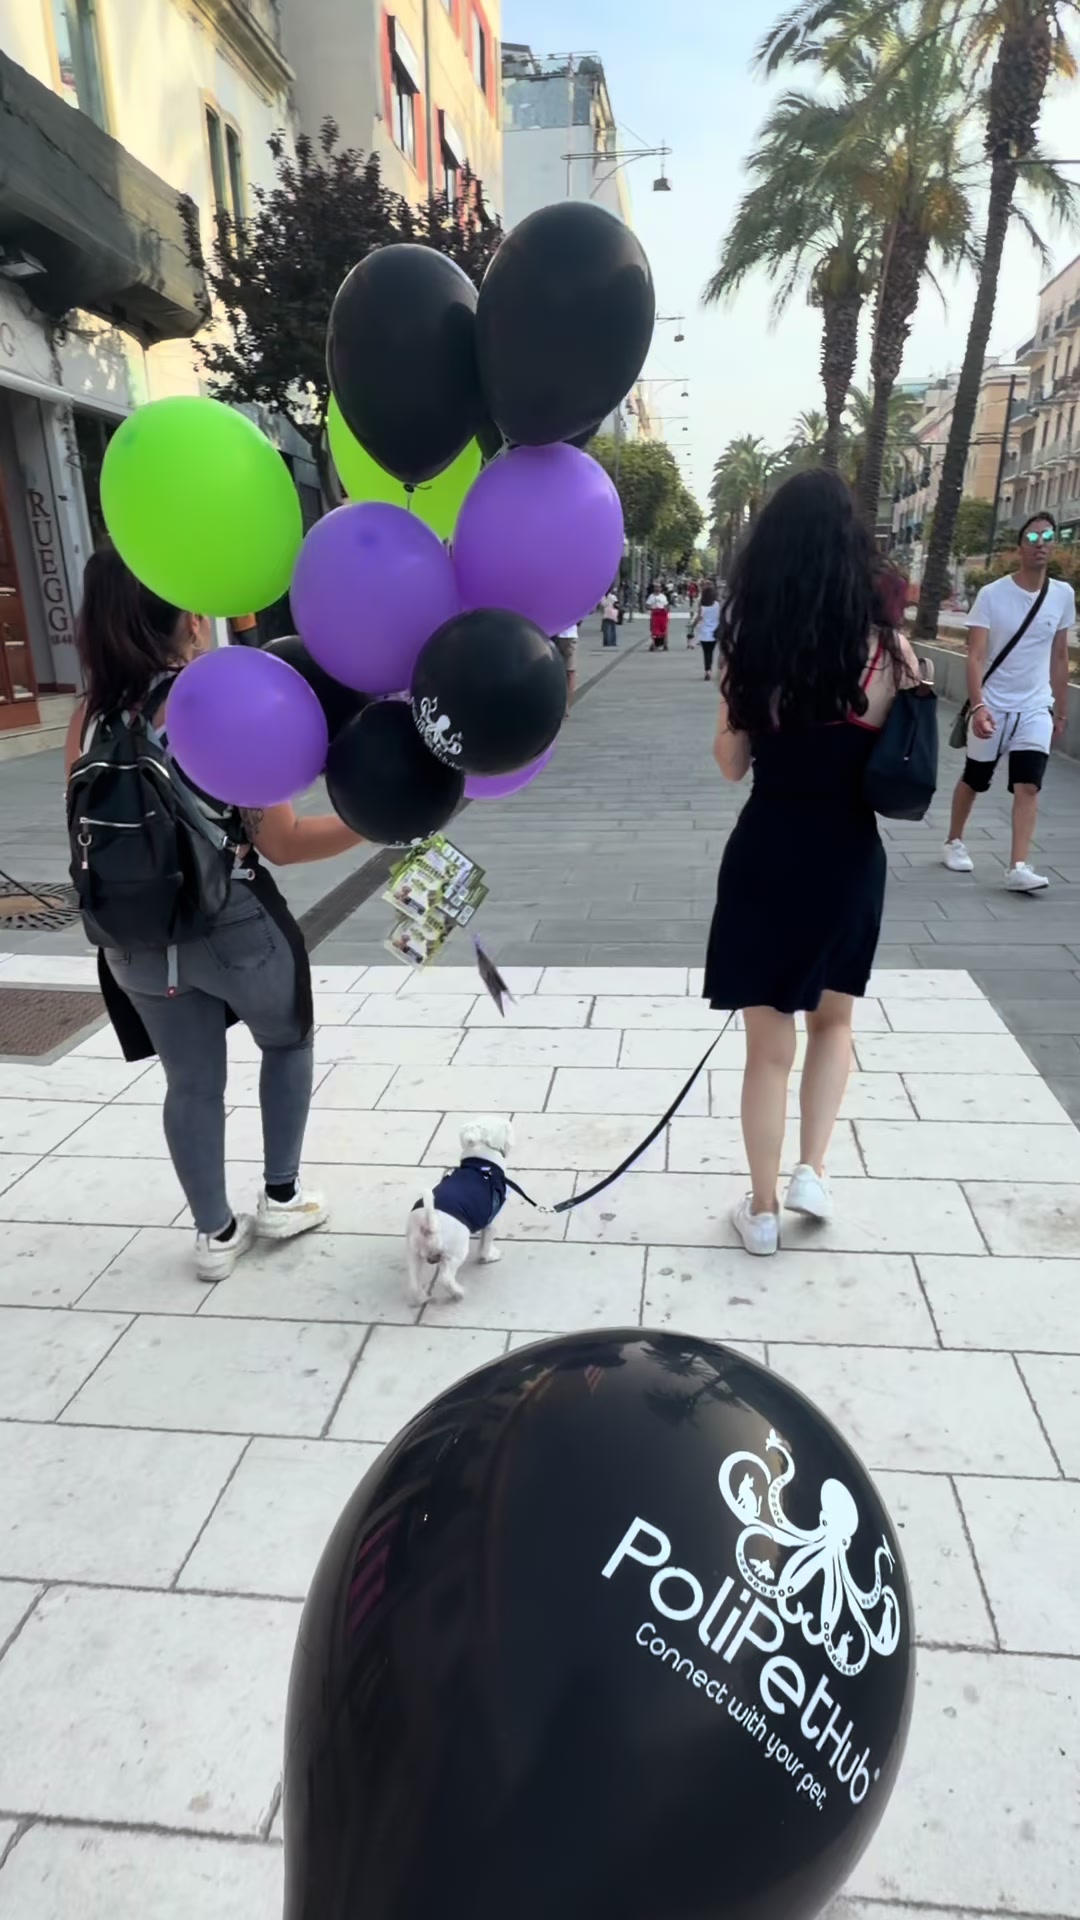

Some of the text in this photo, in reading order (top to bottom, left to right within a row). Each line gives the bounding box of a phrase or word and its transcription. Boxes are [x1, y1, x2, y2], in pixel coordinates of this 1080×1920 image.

[28, 488, 69, 632] RUEGG
[601, 1516, 870, 1805] PoliPetHub
[635, 1622, 729, 1704] Connect
[727, 1696, 768, 1742] with
[764, 1732, 804, 1777] your
